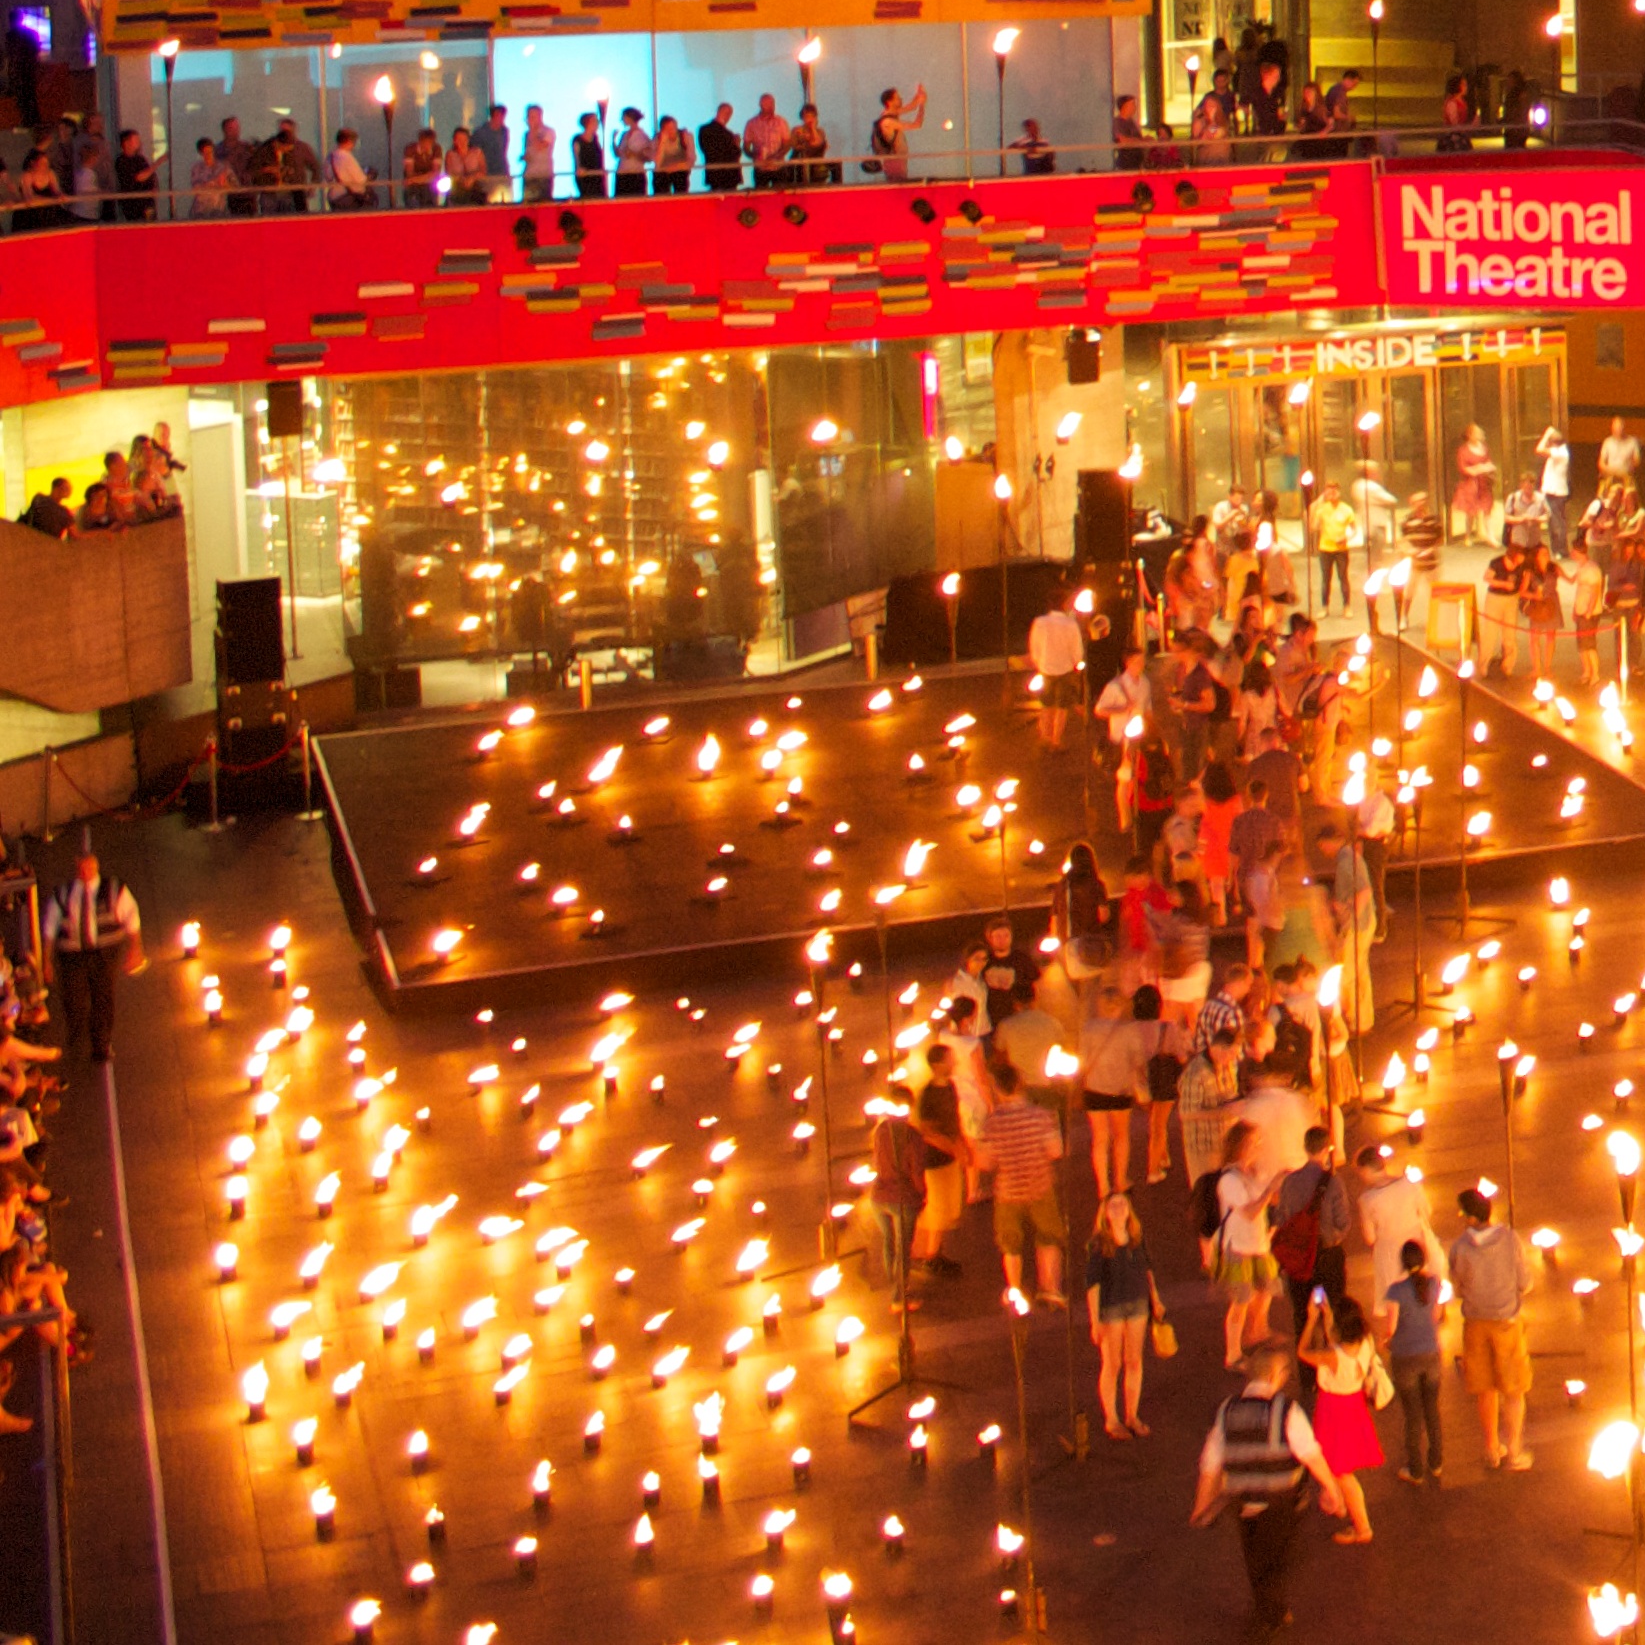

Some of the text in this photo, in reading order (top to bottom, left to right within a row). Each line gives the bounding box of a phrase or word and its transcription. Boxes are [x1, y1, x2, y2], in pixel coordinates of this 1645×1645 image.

[1401, 184, 1633, 247] National
[1401, 239, 1628, 301] Theatre
[1316, 334, 1438, 374] INSIDE
